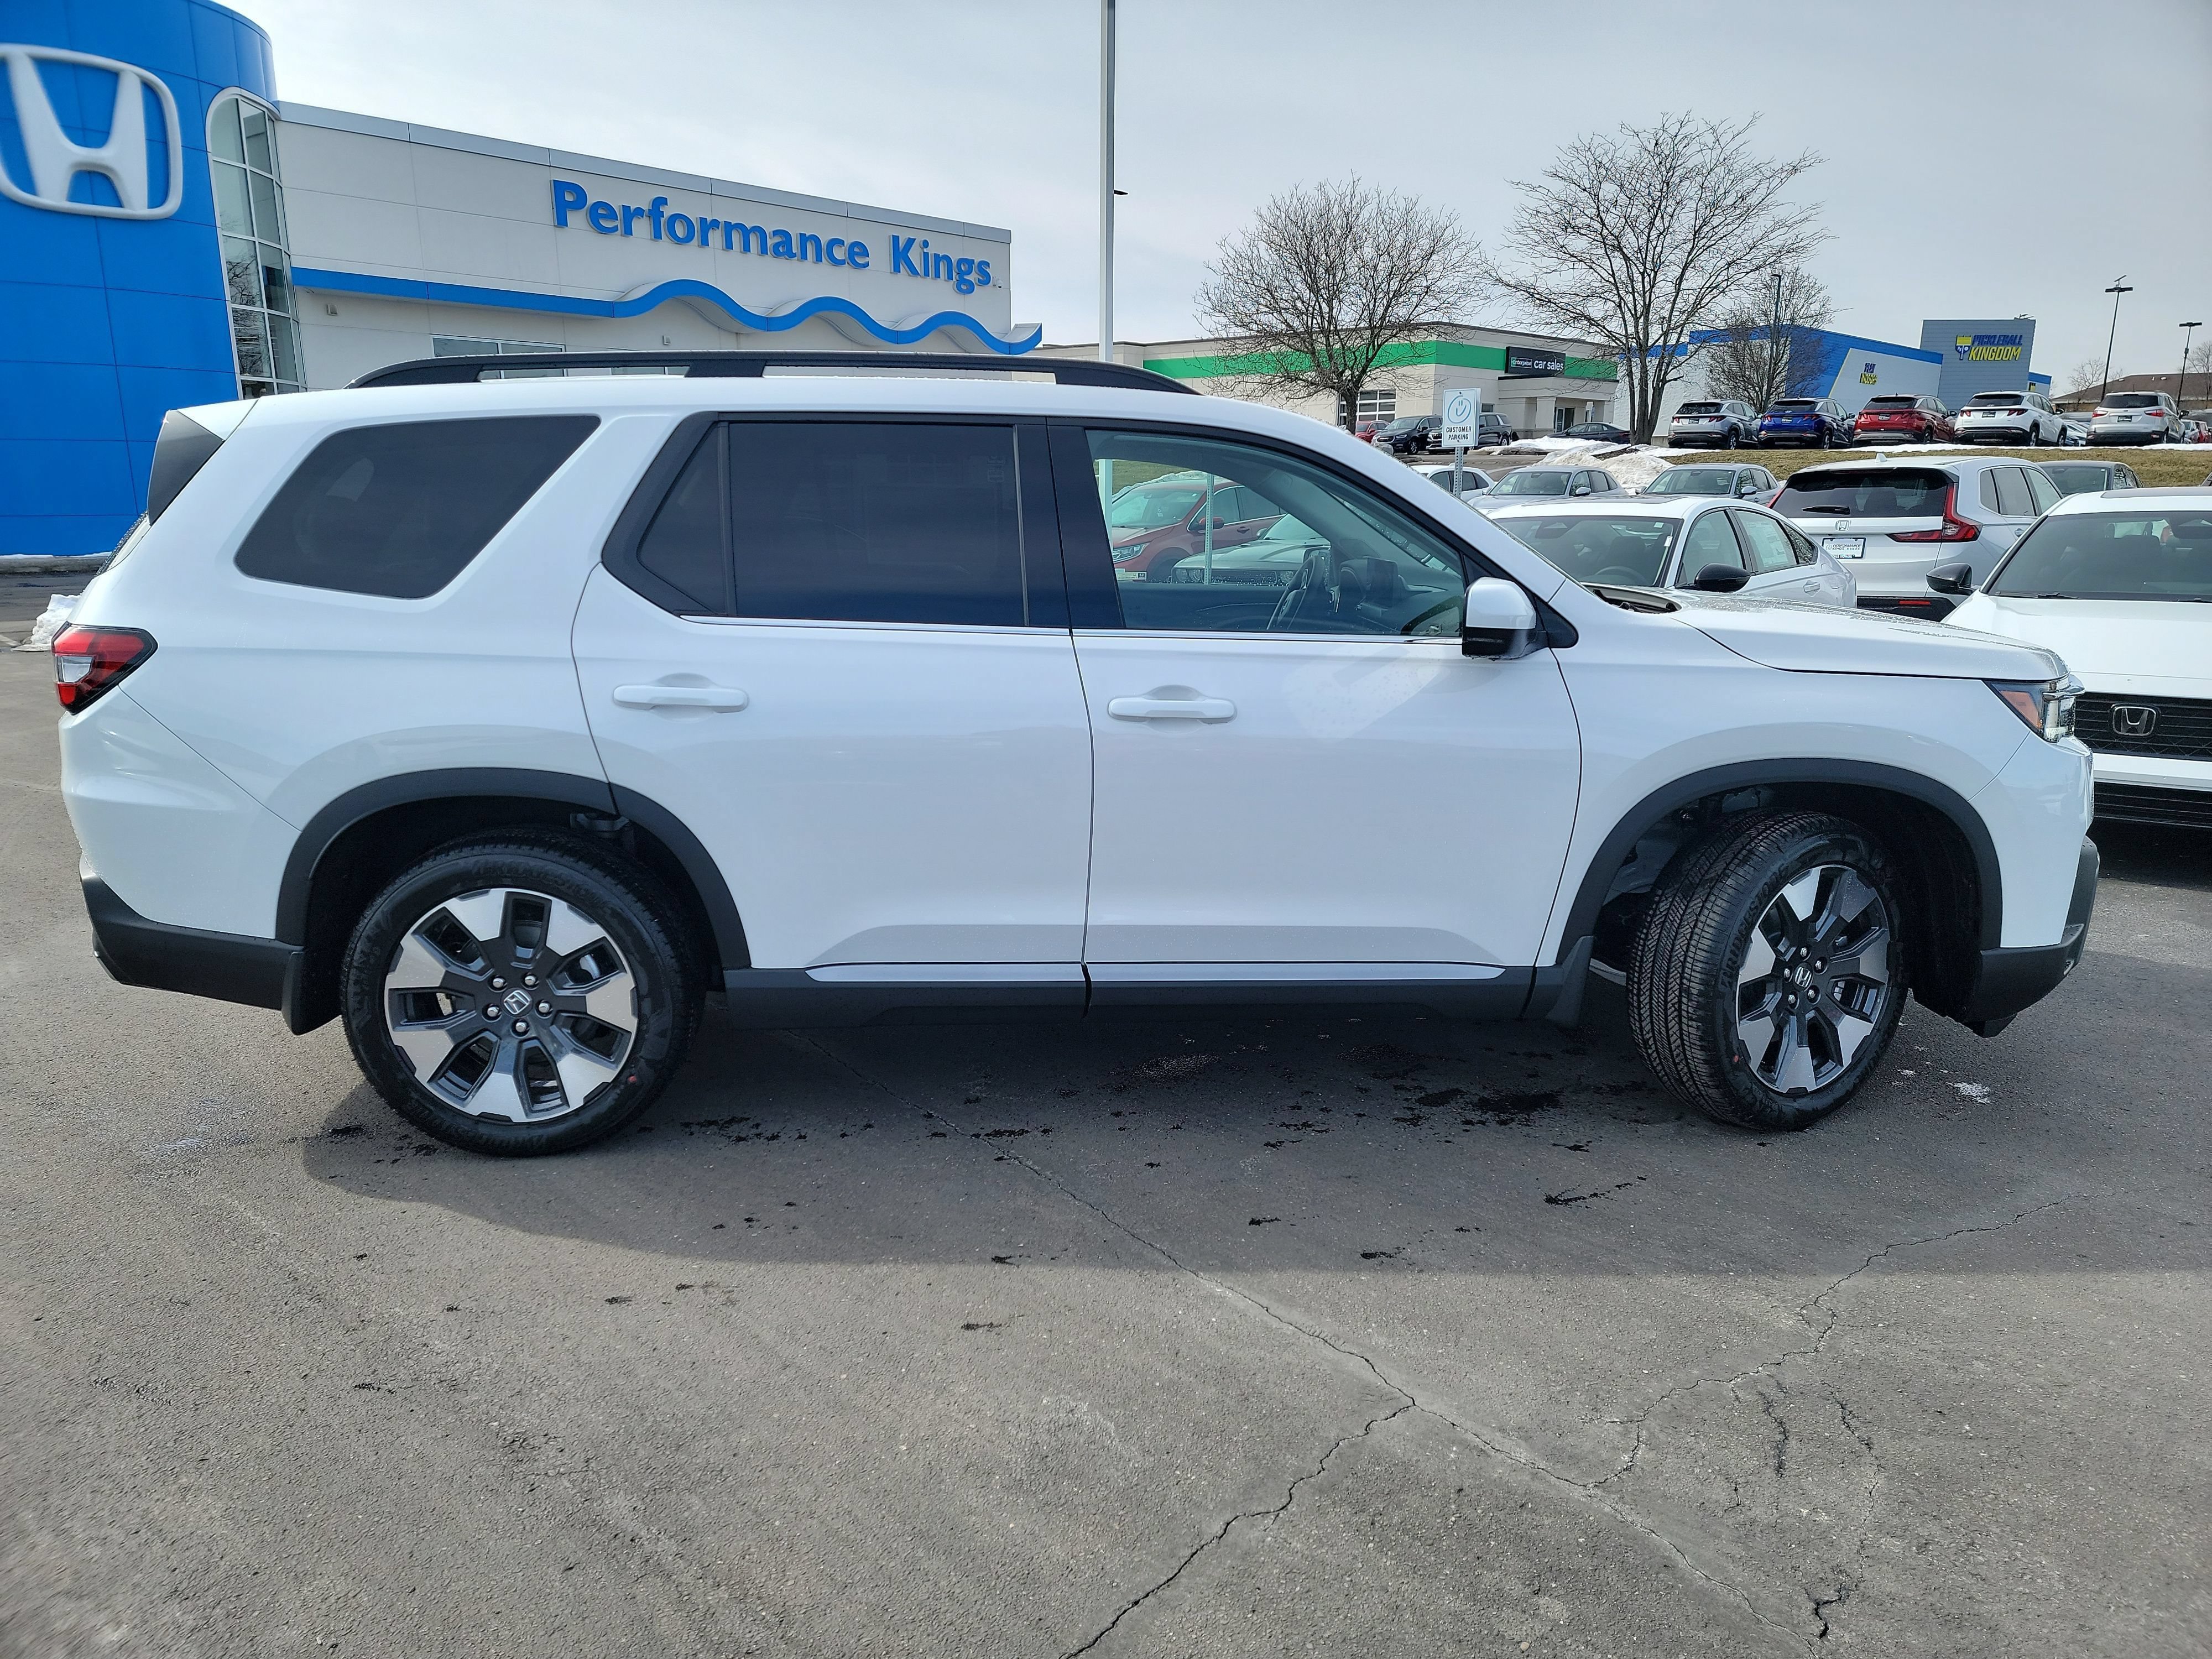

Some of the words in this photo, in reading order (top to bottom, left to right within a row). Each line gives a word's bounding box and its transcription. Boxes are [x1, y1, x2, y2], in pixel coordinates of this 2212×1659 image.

[551, 179, 870, 269] Performance
[890, 234, 991, 295] Kings
[1972, 334, 2023, 346] PICKLEBALL
[1968, 347, 2022, 361] KINGDOM
[1533, 360, 1546, 369] car
[1547, 358, 1564, 371] sales
